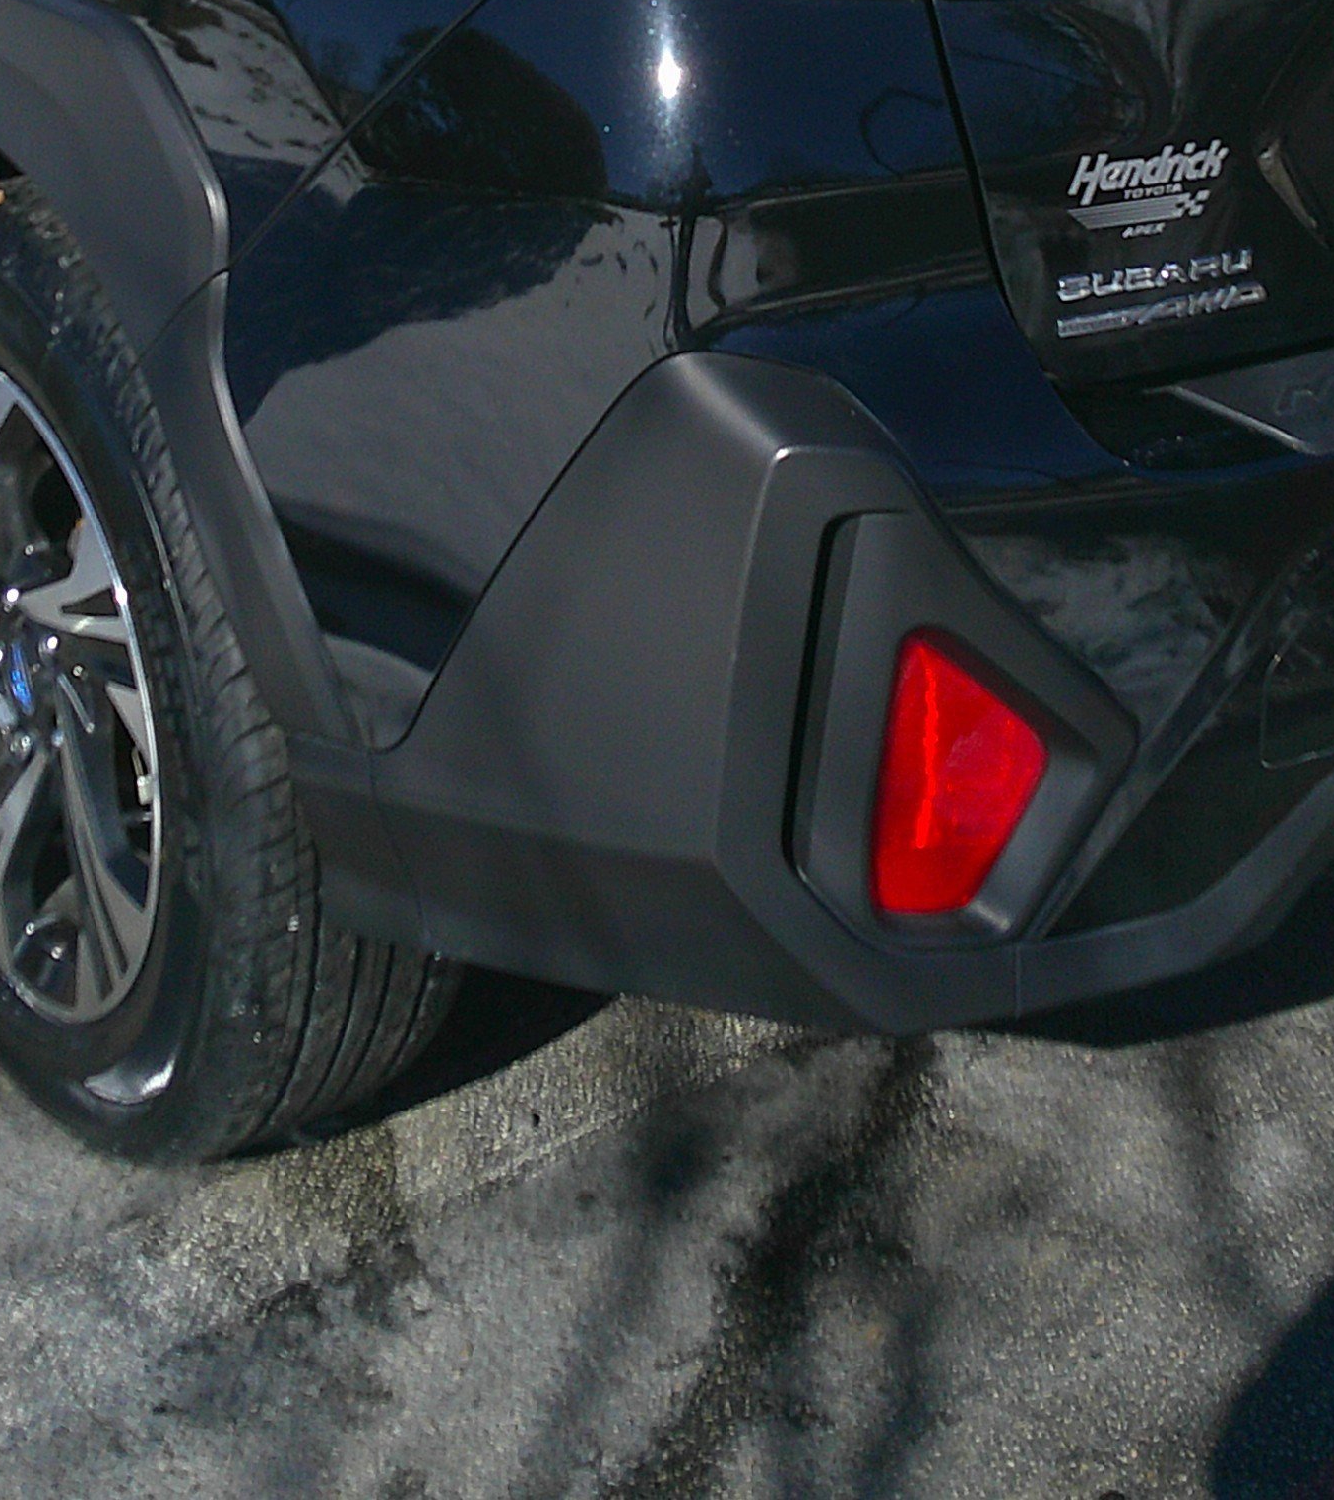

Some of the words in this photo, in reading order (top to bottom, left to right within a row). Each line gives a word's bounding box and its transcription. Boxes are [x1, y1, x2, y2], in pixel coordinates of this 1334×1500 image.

[1067, 139, 1229, 206] Hendrick
[1123, 182, 1182, 200] TOYOTA
[1122, 222, 1166, 239] APEX
[1057, 249, 1253, 302] SUBARU
